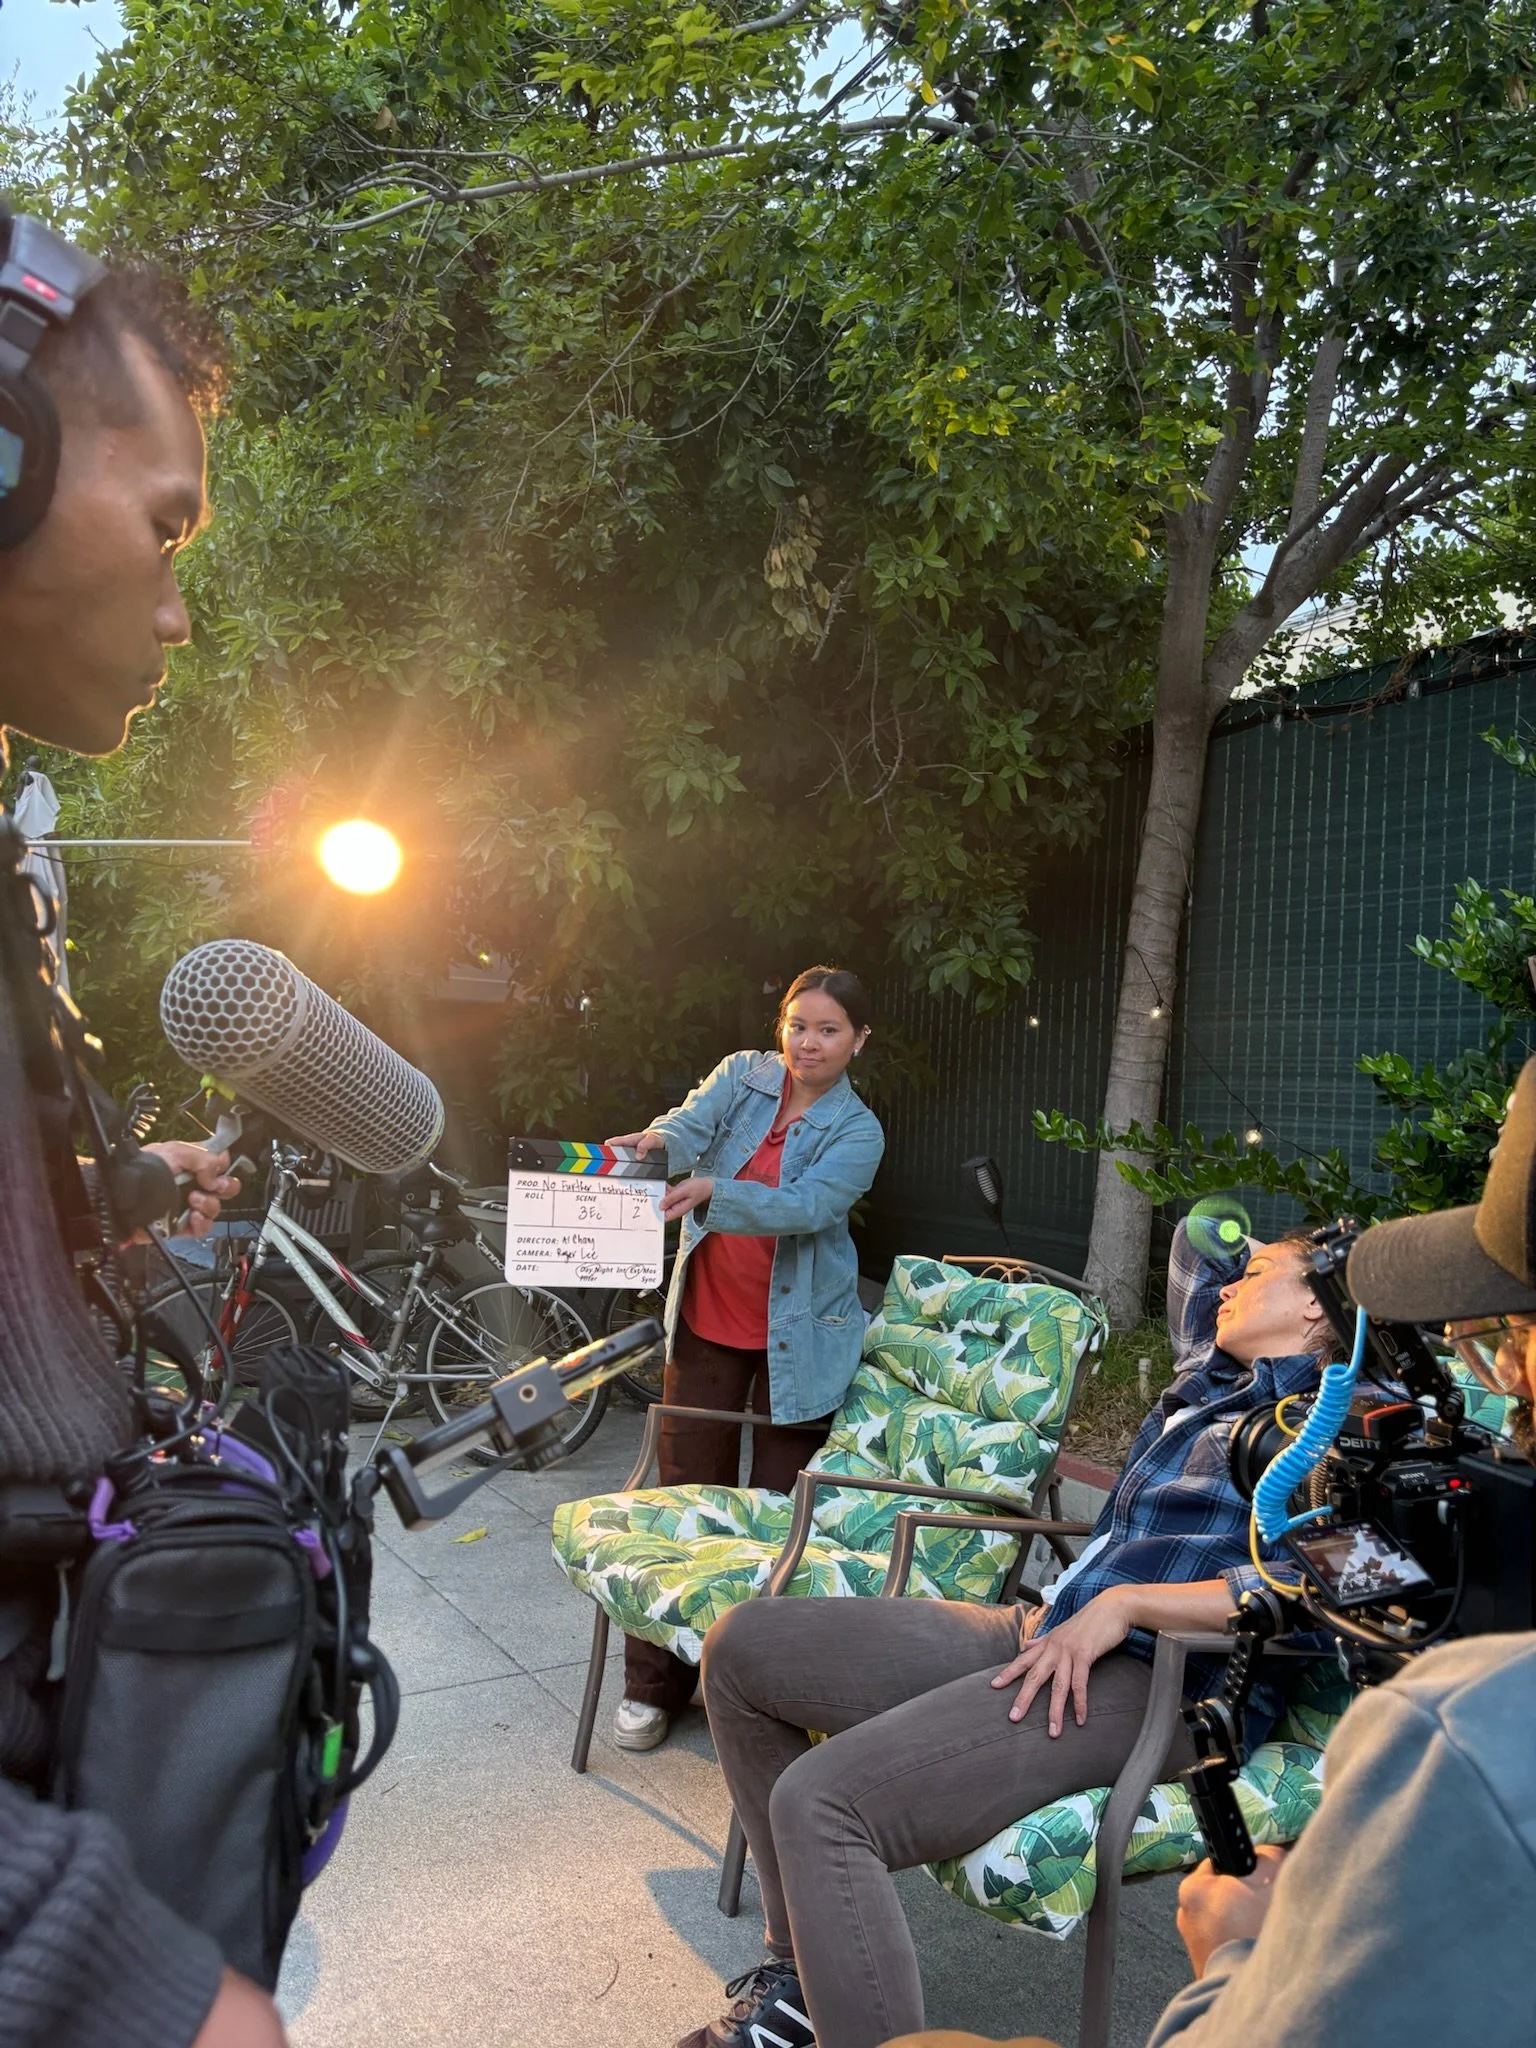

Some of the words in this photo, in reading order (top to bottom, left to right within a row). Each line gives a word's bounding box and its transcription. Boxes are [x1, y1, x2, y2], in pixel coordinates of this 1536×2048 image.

[543, 1176, 556, 1191] No
[562, 1178, 592, 1192] Further
[576, 1194, 597, 1202] SCENE
[632, 1206, 640, 1219] 2
[517, 1236, 559, 1244] DIRECTOR:
[516, 1249, 552, 1257] CAMERA:
[580, 1247, 598, 1260] Lee
[580, 1266, 592, 1274] Day
[594, 1266, 614, 1274] Night
[641, 1275, 657, 1284] Sync
[1338, 1436, 1381, 1450] DEITY
[1399, 1471, 1426, 1480] SONY
